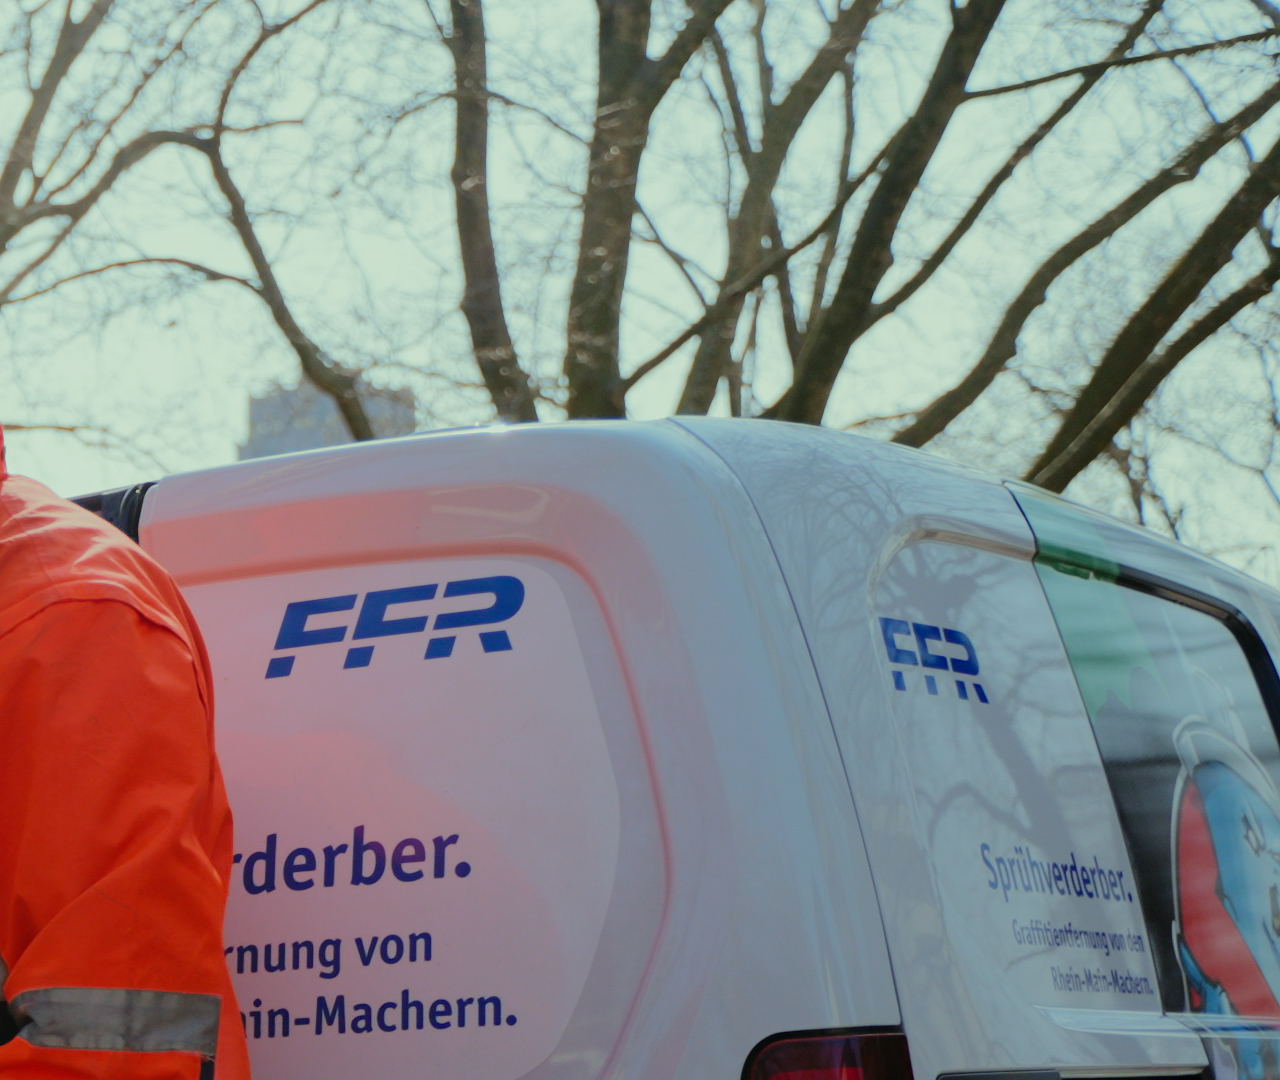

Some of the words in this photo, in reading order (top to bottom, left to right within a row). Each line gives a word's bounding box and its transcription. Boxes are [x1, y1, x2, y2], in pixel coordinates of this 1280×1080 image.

[264, 575, 526, 679] FFR
[879, 617, 990, 704] FFR
[980, 843, 1133, 902] Sprühverderber.
[355, 931, 432, 966] von
[1012, 919, 1109, 956] Graffitientfernung
[1109, 930, 1126, 951] von
[1127, 928, 1145, 952] den
[1051, 966, 1154, 995] Rhein-Main-Machern.
[241, 989, 518, 1038] in-Machern.
